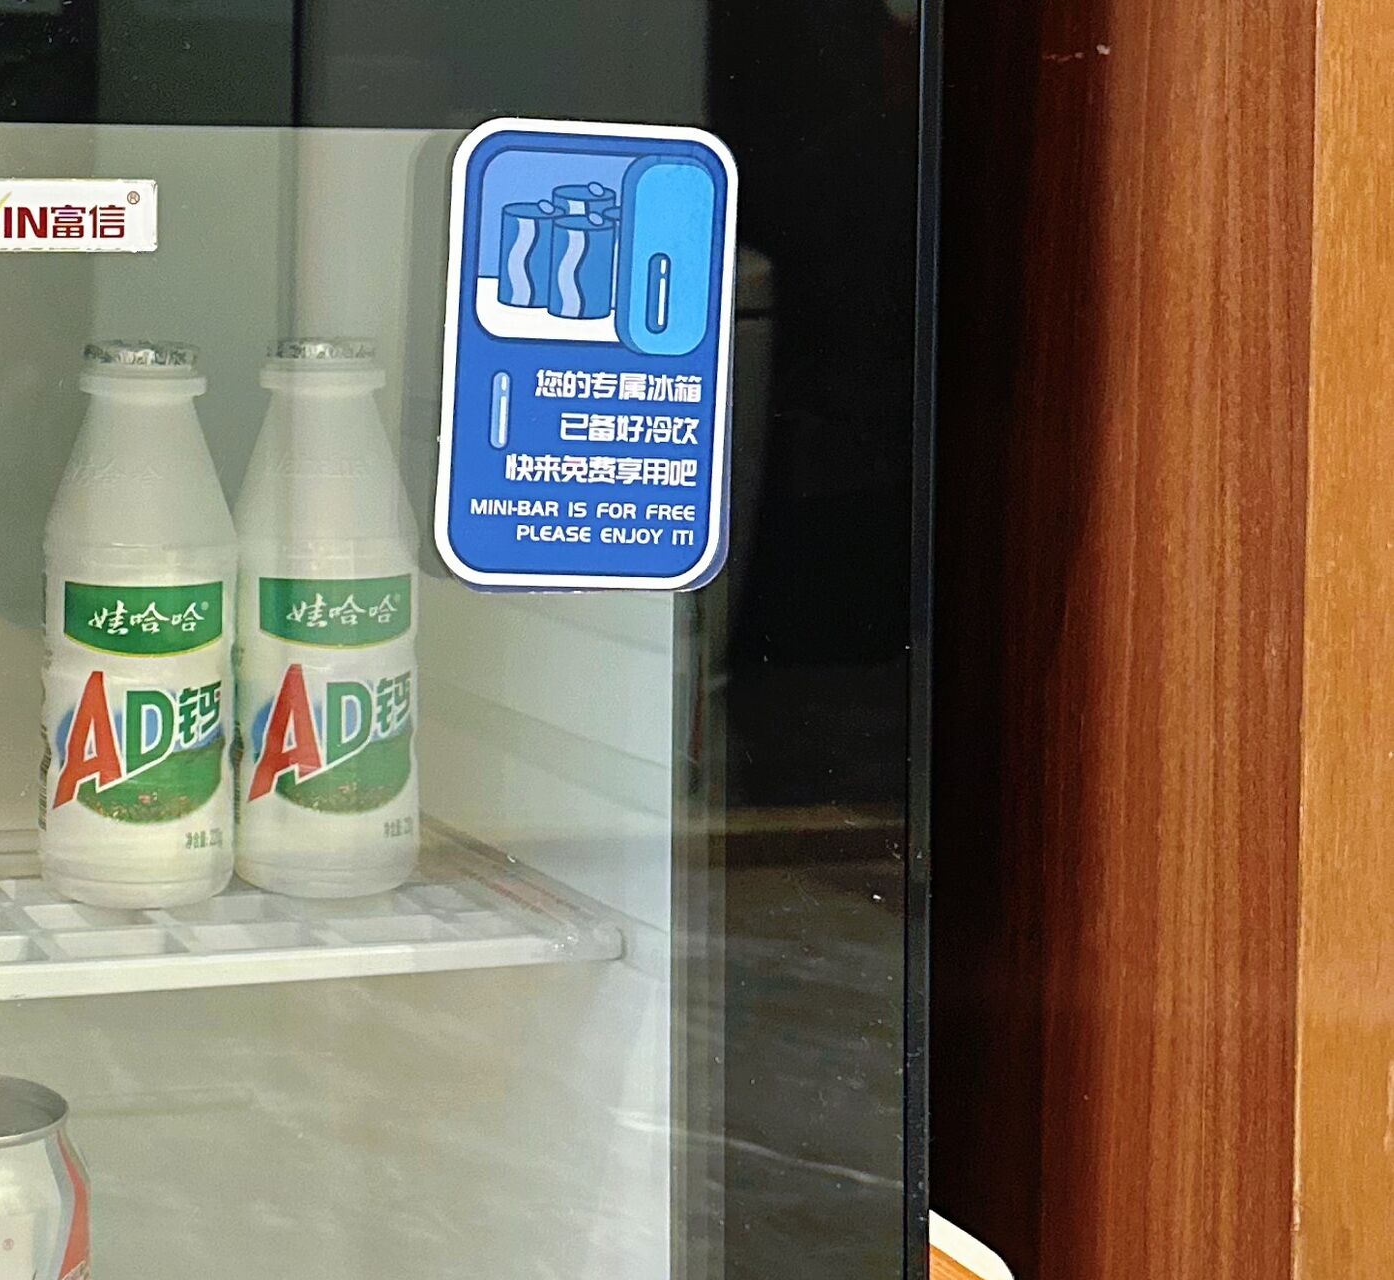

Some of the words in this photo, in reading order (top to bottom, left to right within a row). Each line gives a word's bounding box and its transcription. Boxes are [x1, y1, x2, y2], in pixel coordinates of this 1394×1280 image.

[534, 369, 702, 404] 您的专属冰箱
[559, 411, 699, 445] 已备好冷饮
[505, 452, 697, 487] 快来免费享用吧
[470, 498, 559, 518] MINI-BAR
[568, 501, 587, 518] IS
[596, 502, 636, 521] FOR
[645, 504, 696, 521] FREE
[516, 524, 591, 543] PLEASE
[600, 526, 662, 545] ENJOY
[672, 527, 694, 546] IT!
[88, 600, 205, 635] 娃哈哈
[286, 593, 398, 628] 娃哈哈
[53, 670, 222, 809] AD钙
[248, 663, 412, 802] AD钙
